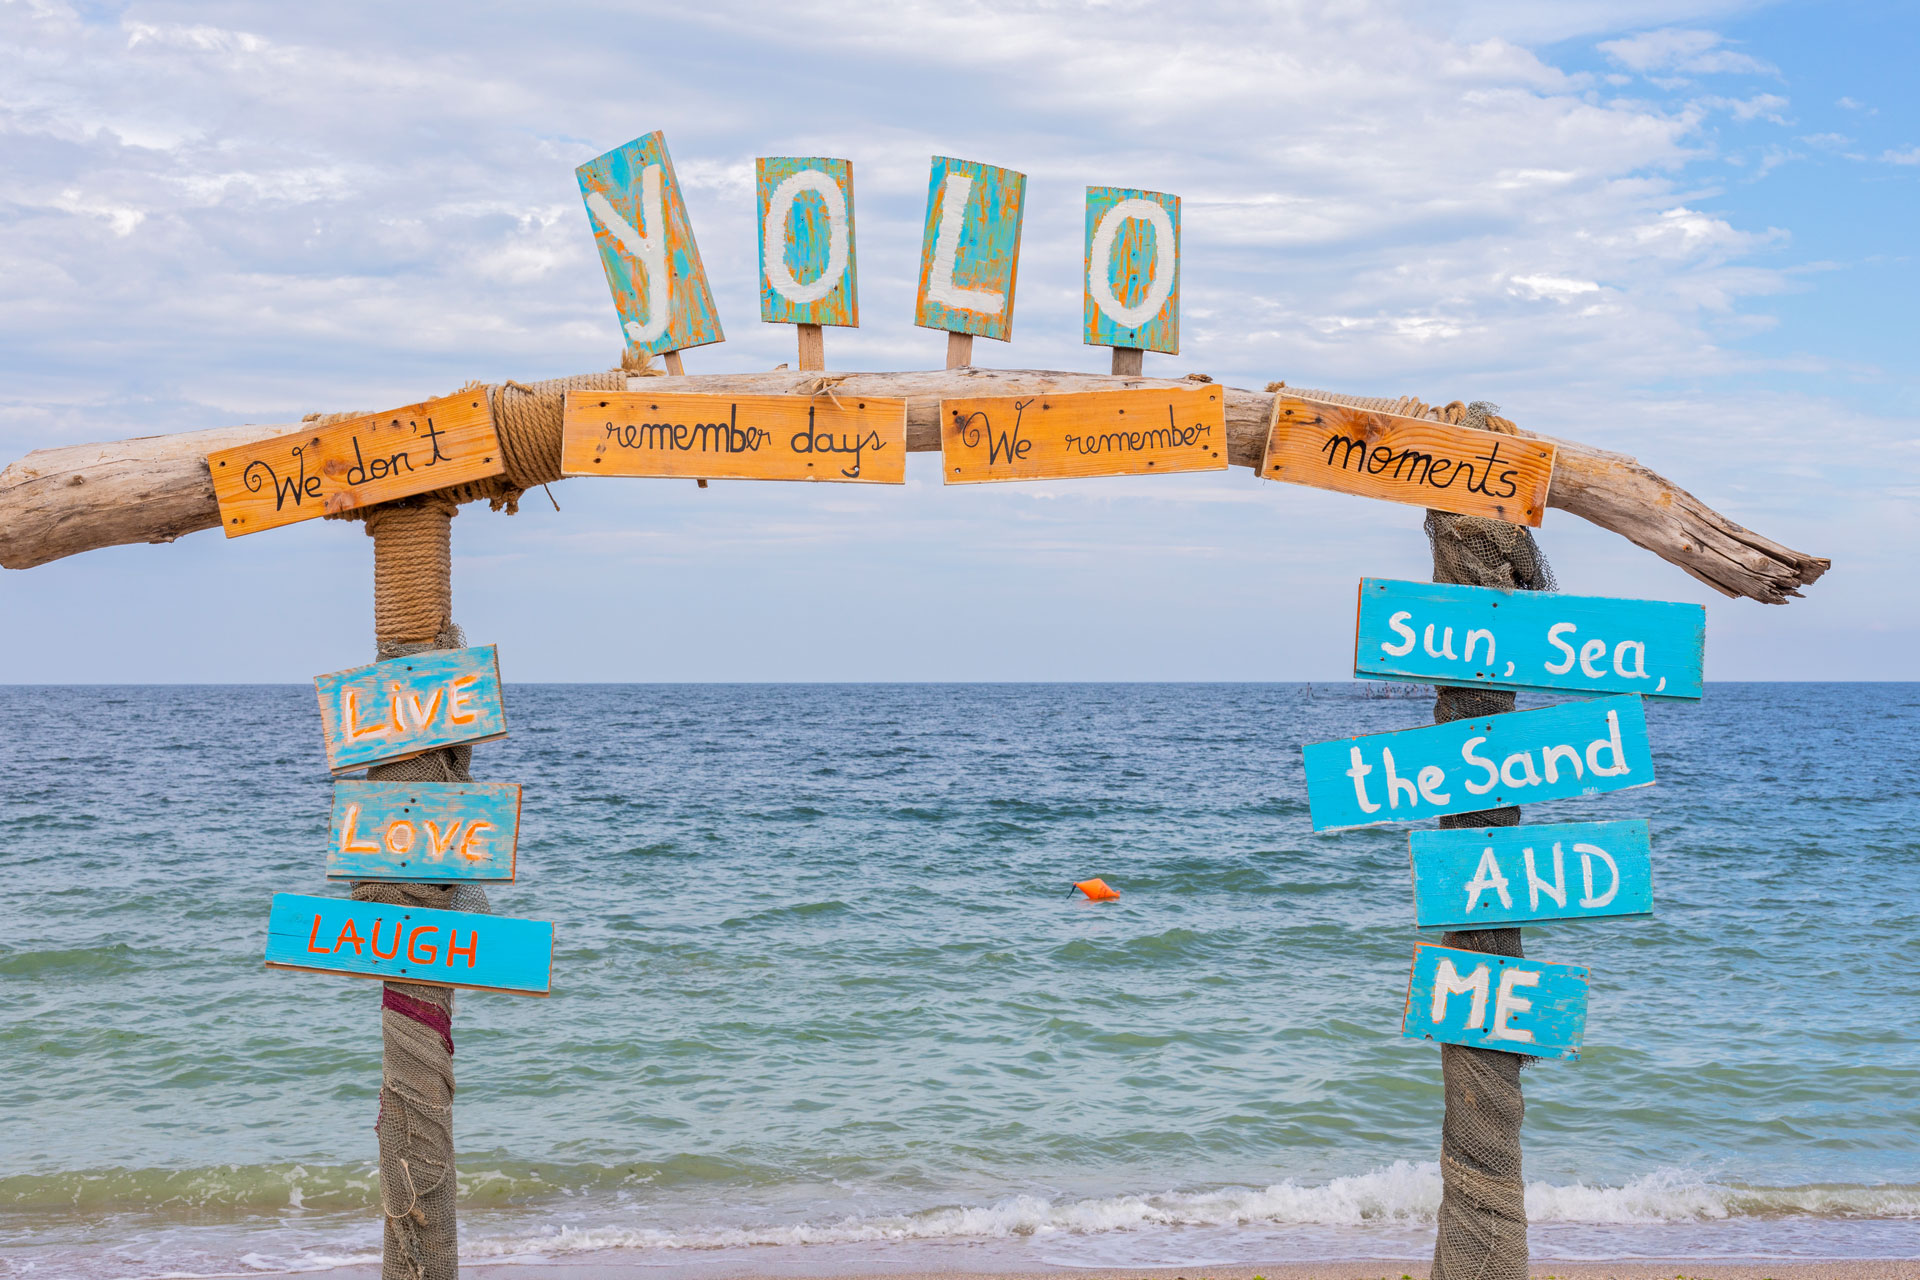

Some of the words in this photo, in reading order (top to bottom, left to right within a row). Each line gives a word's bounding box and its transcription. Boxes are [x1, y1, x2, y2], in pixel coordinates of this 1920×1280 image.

[585, 163, 1176, 343] YOLO
[243, 443, 323, 512] We
[345, 417, 453, 488] don't
[605, 403, 772, 454] remember
[790, 405, 887, 478] days
[961, 398, 1035, 466] We
[1065, 404, 1212, 455] remember
[1321, 433, 1518, 499] moments
[1381, 611, 1514, 678] Sun,
[1544, 622, 1666, 693] Sea,
[1346, 746, 1450, 814] the
[1461, 709, 1631, 796] Sand
[1464, 841, 1620, 914] AND
[307, 914, 479, 968] LAUGH
[1431, 959, 1540, 1043] ME
